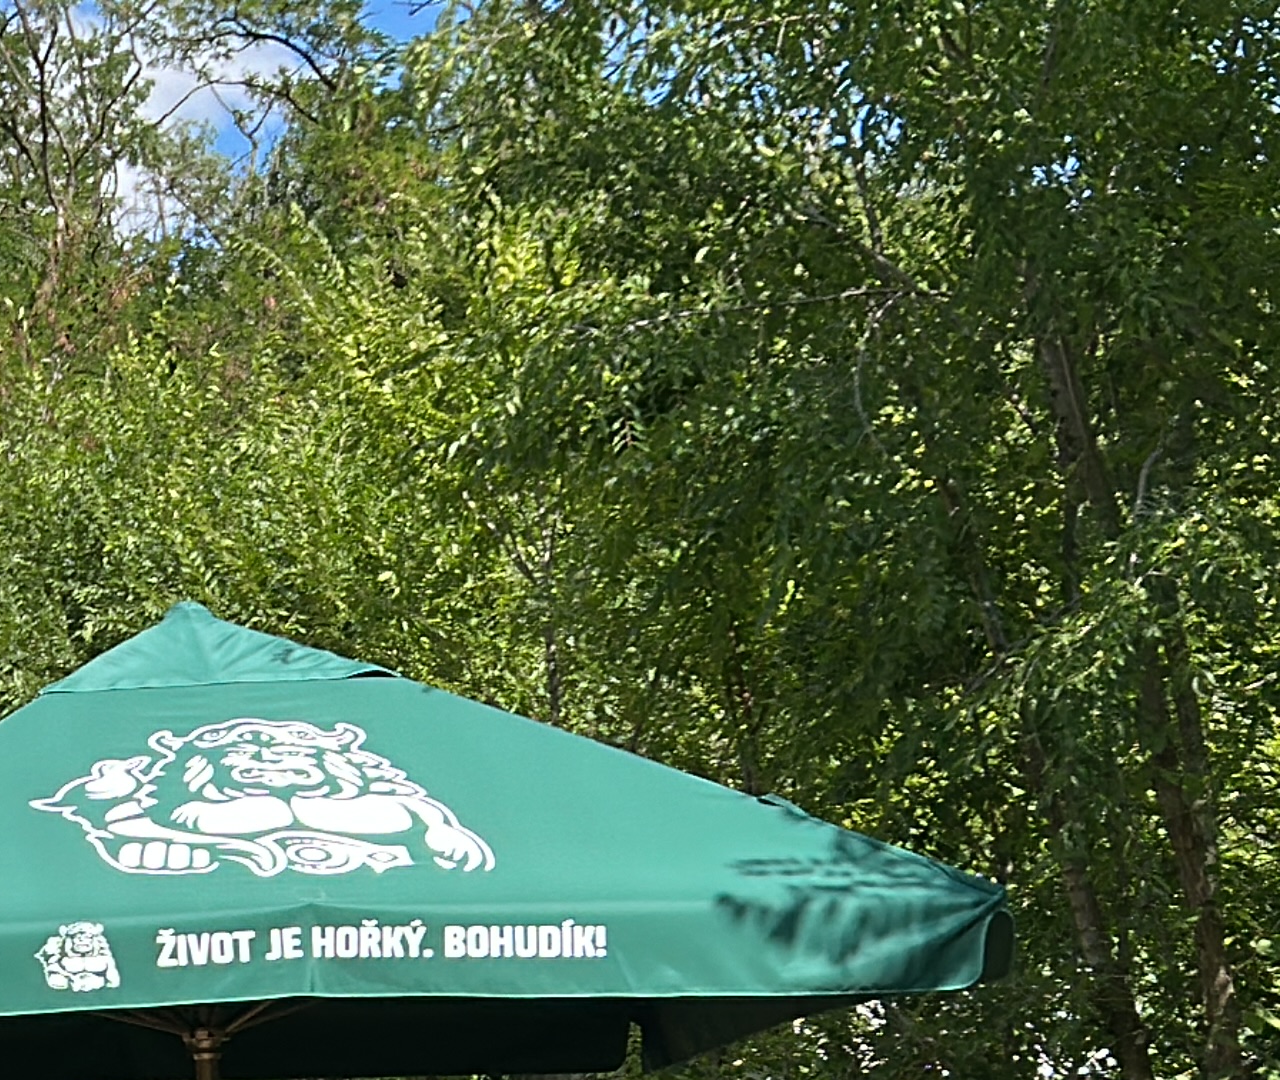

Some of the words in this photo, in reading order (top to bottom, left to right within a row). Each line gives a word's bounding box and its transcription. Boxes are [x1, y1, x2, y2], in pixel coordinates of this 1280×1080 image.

[155, 926, 256, 968] ŽIVOT
[264, 926, 304, 962] JE
[311, 918, 434, 960] HOŘKÝ.
[444, 918, 608, 959] BOHUDÍK!
